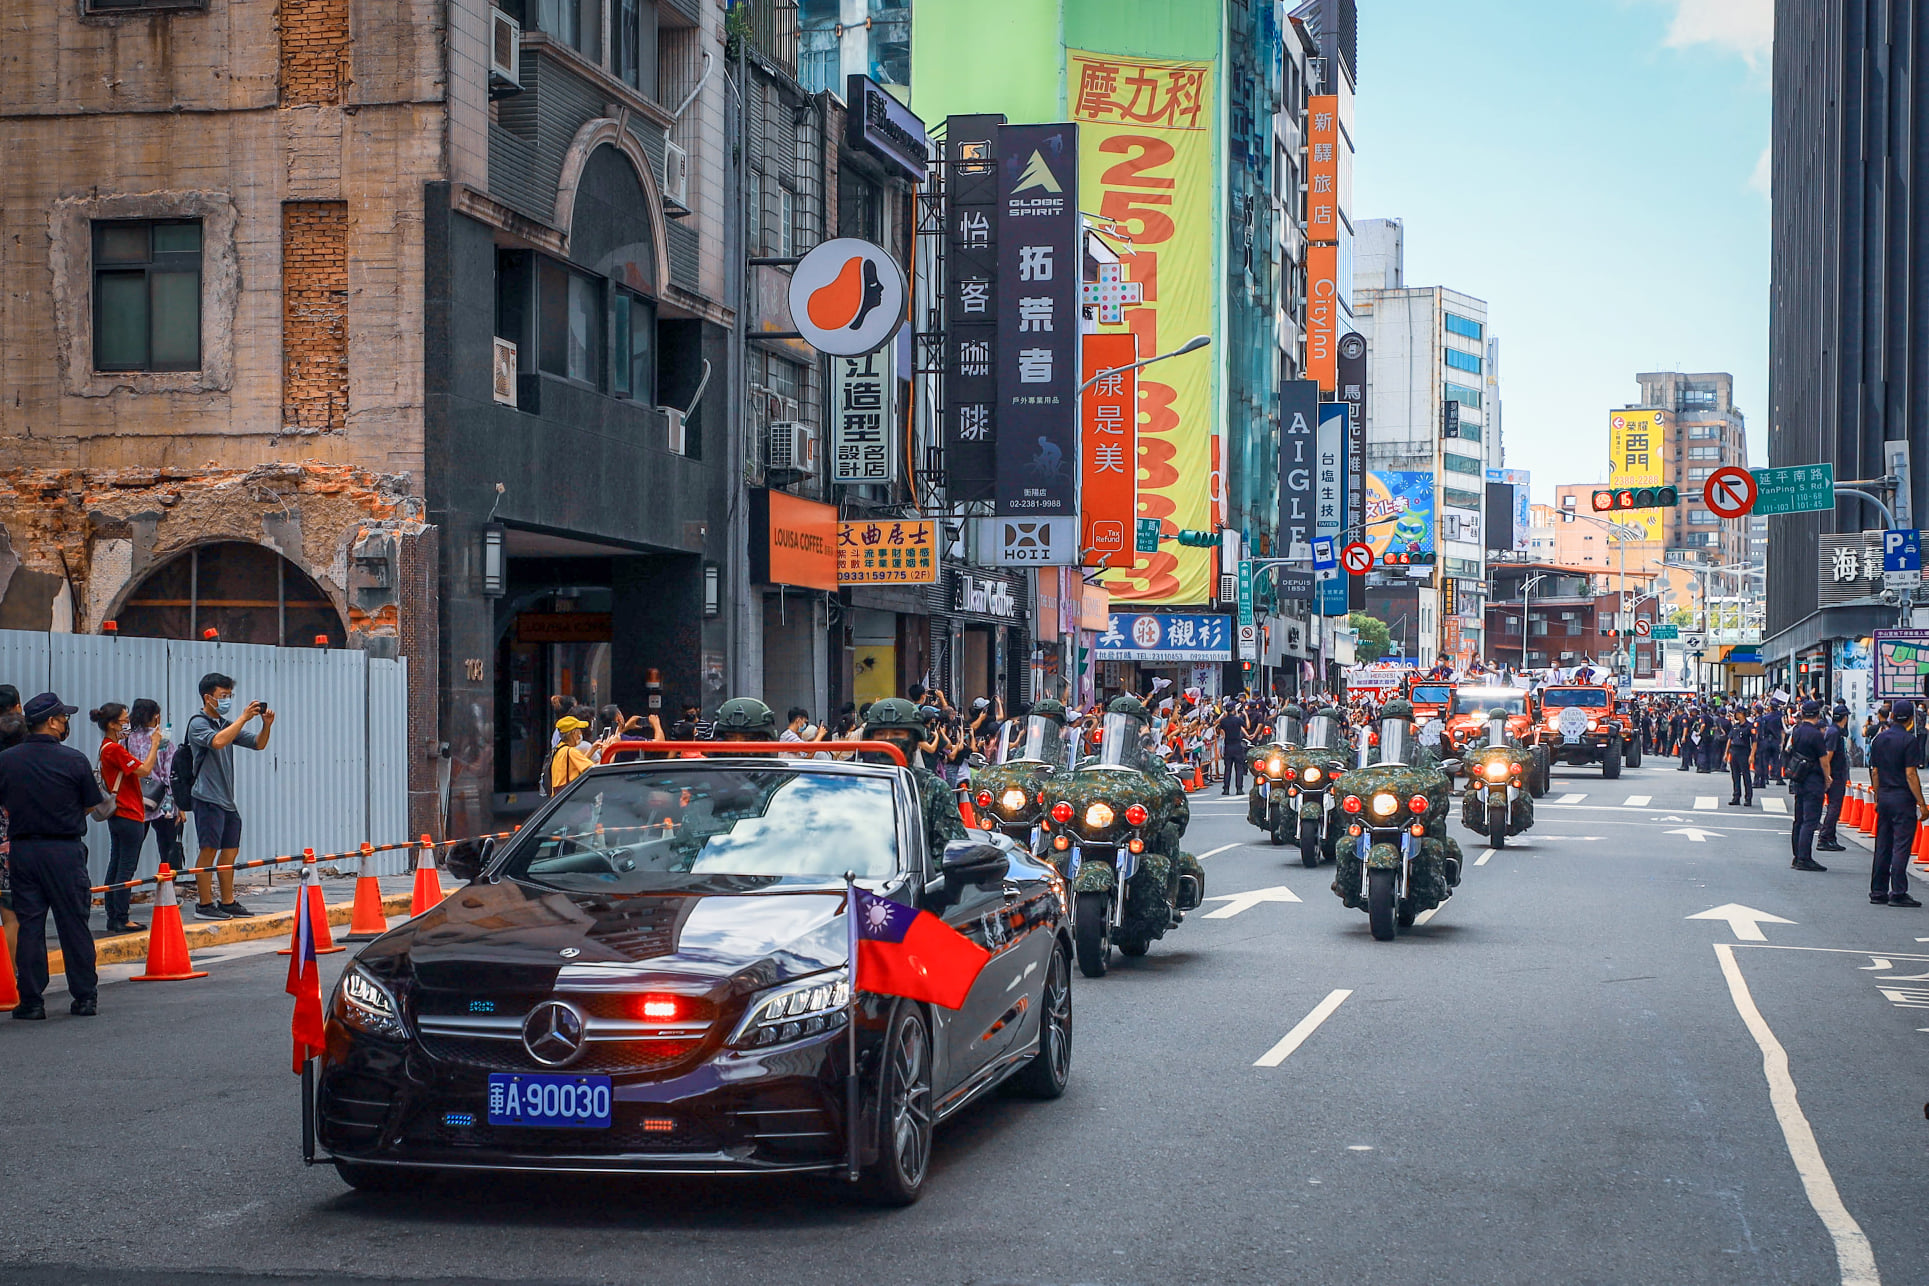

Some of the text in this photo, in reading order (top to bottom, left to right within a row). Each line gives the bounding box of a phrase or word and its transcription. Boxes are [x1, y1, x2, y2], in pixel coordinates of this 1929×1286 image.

[1075, 63, 1204, 128] 摩力科
[1313, 111, 1333, 226] 新驛旅店
[1008, 199, 1064, 207] GLOBE
[1008, 208, 1064, 217] SPIRIT
[1018, 244, 1055, 385] 拓荒者
[960, 211, 990, 441] 怡客咖啡
[1093, 366, 1125, 474] 康是美
[1625, 433, 1649, 473] 西門
[1287, 411, 1311, 545] AIGLE
[1320, 452, 1335, 518] 台塩生技
[1759, 467, 1824, 485] 延平南路
[1760, 486, 1795, 495] YanPing
[1811, 482, 1825, 490] Rd.
[1009, 499, 1062, 508] 02-2381-9988
[774, 527, 799, 550] LOUISA
[799, 532, 824, 555] COFFEE
[837, 522, 929, 546] 文曲居士
[1095, 534, 1120, 543] Refund
[1108, 528, 1120, 537] Tax
[1886, 533, 1904, 554] P
[1004, 549, 1050, 560] HOII
[837, 570, 931, 581] 0933159775 (2F)
